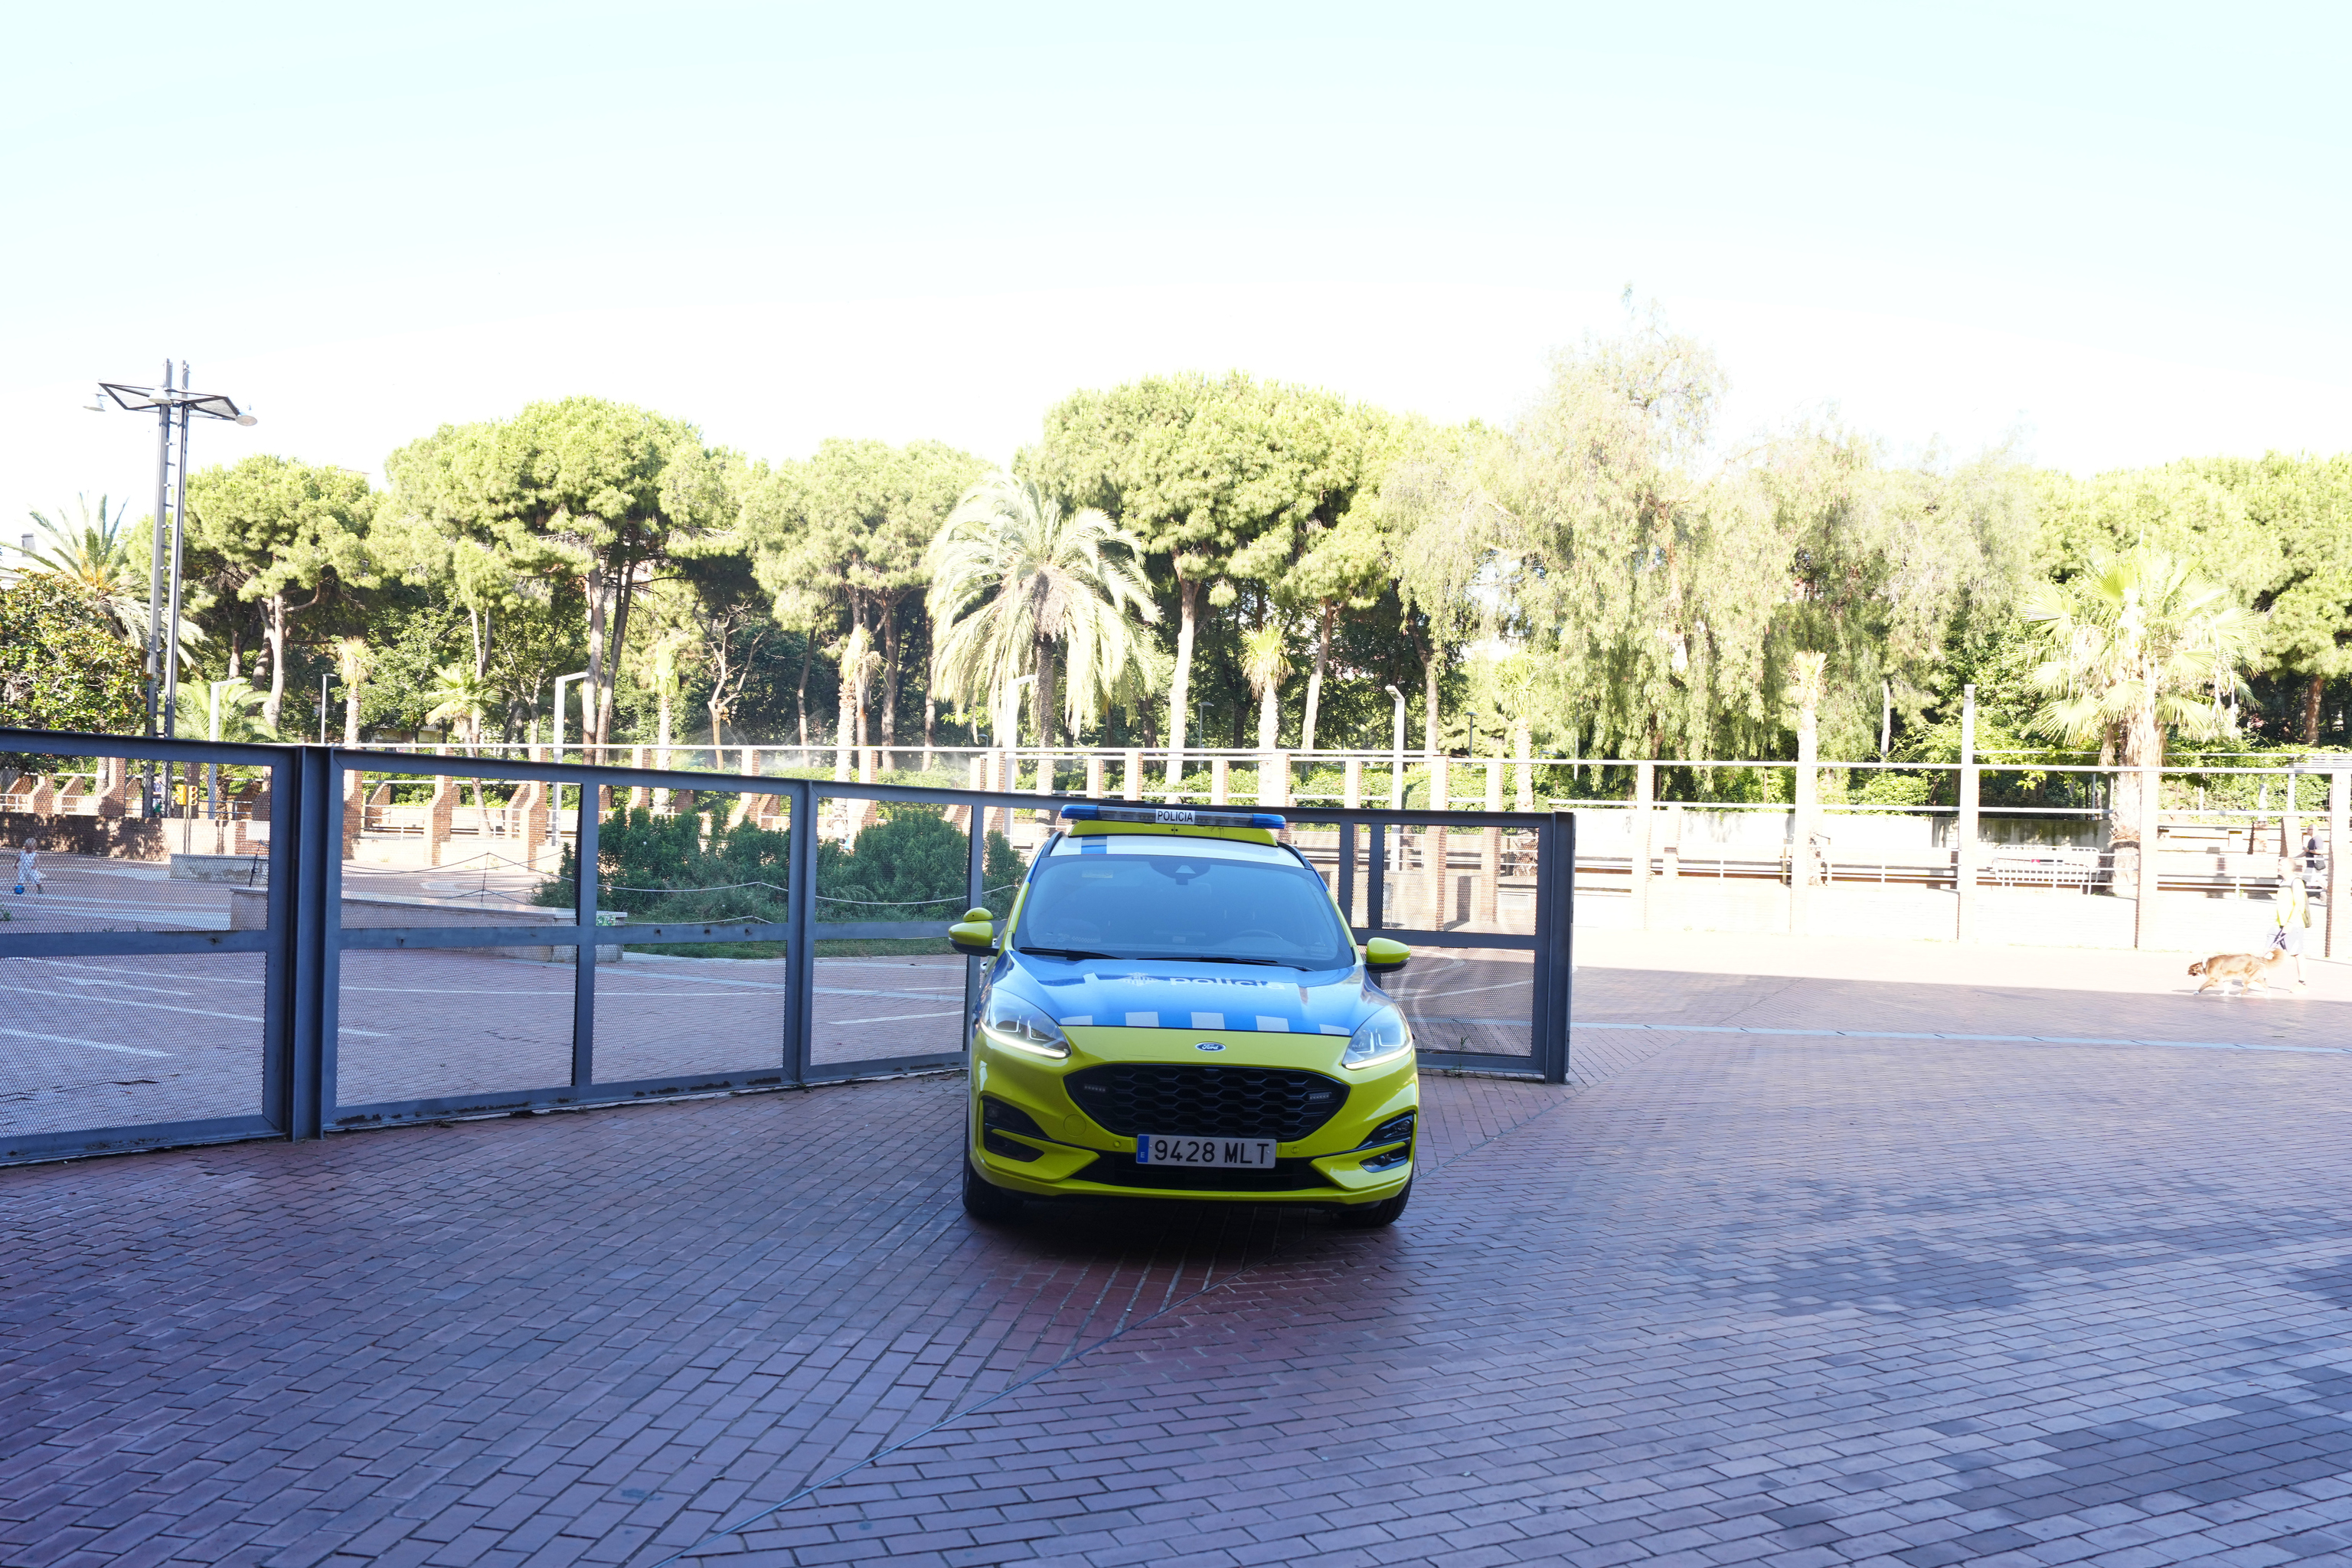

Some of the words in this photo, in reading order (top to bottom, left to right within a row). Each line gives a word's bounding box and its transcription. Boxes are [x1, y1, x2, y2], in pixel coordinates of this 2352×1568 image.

[1158, 811, 1193, 822] POLICIA
[1170, 978, 1285, 989] policia
[1155, 1140, 1215, 1162] 9428
[1224, 1142, 1269, 1164] MLT
